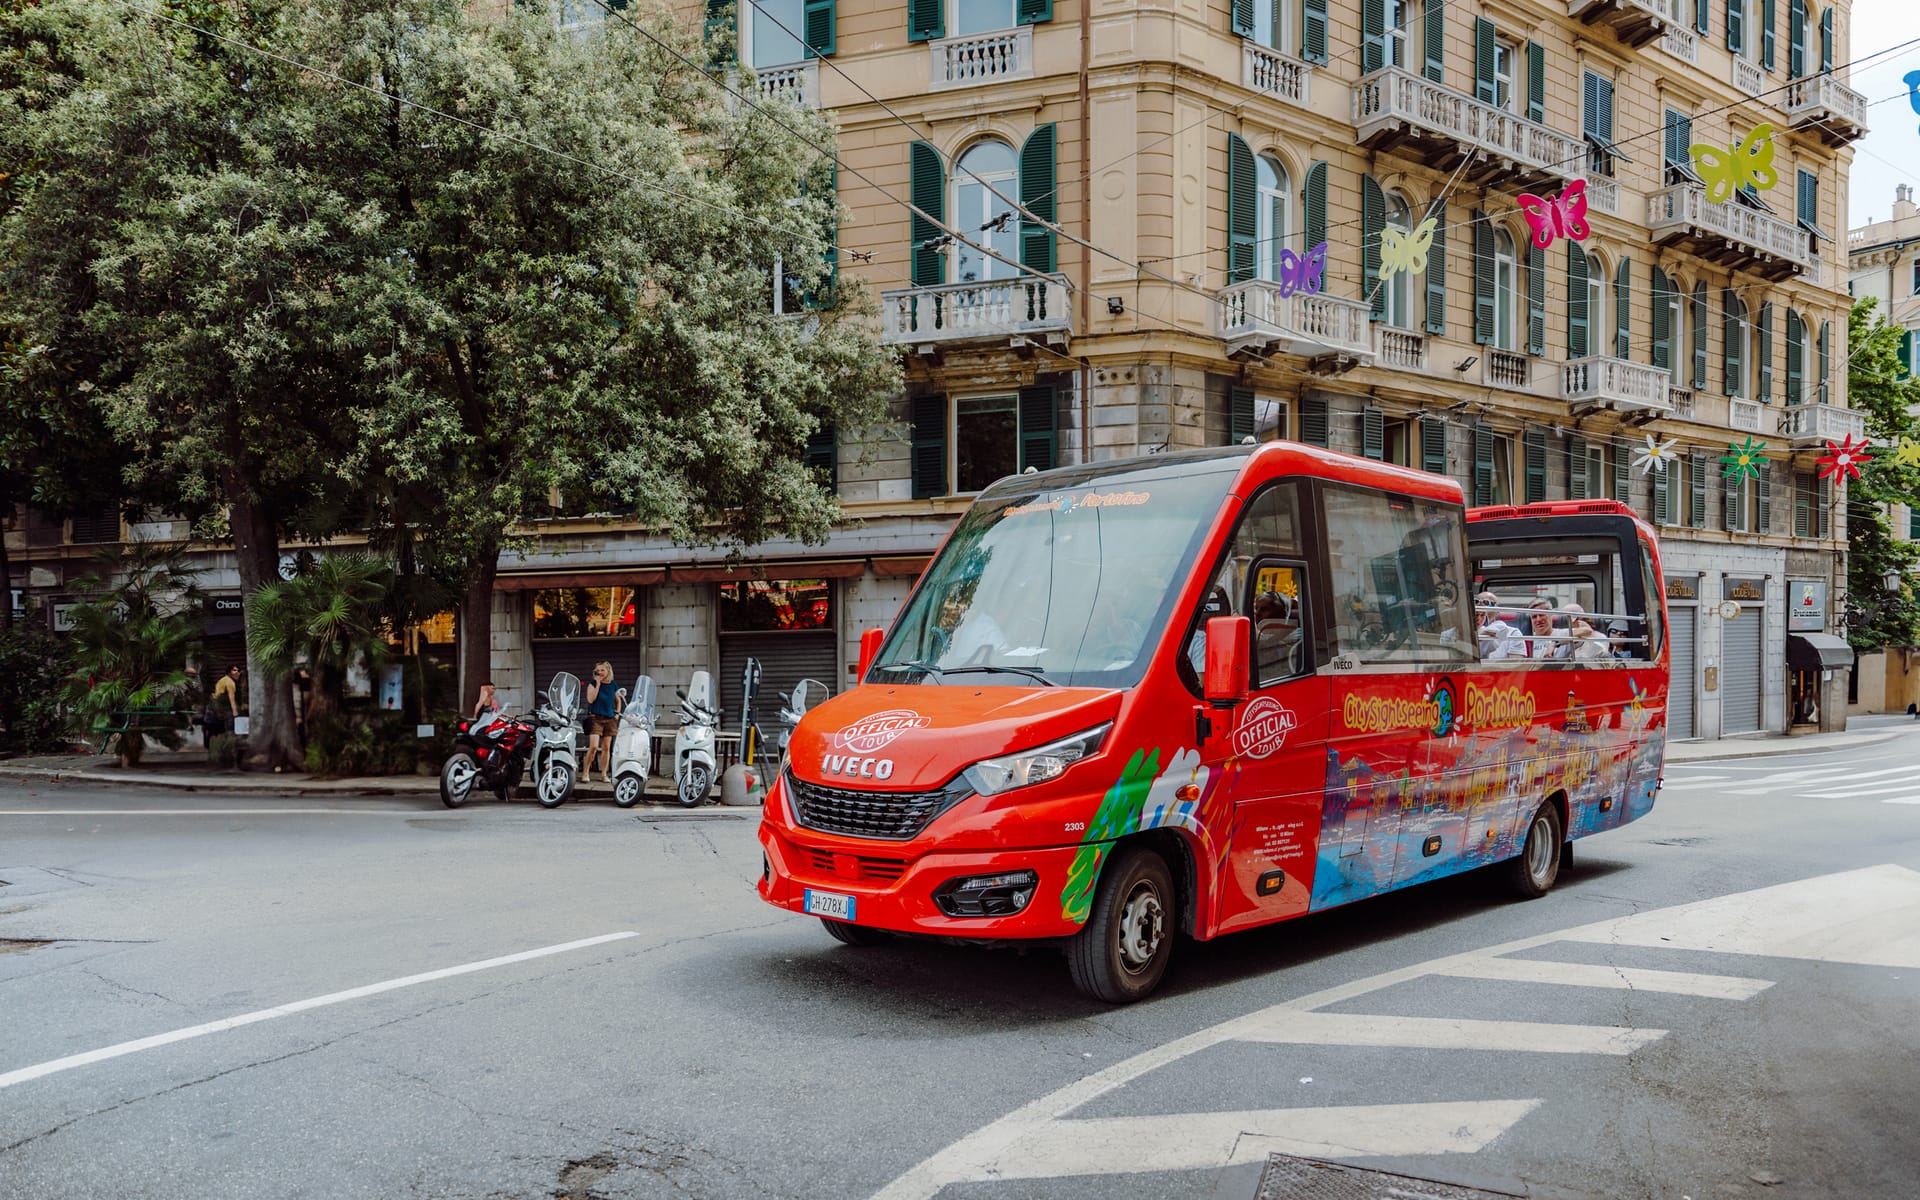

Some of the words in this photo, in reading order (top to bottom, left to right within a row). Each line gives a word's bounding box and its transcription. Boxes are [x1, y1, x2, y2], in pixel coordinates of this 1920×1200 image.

[216, 600, 241, 609] Chiara
[1333, 661, 1353, 670] IVECO
[1464, 682, 1536, 727] Portofino
[843, 718, 923, 741] OFFICIAL
[1240, 713, 1294, 748] OFFICIAL
[860, 731, 896, 748] TOUR
[1257, 736, 1282, 754] TOUR
[822, 754, 894, 779] IVECO
[1064, 822, 1085, 832] 2303
